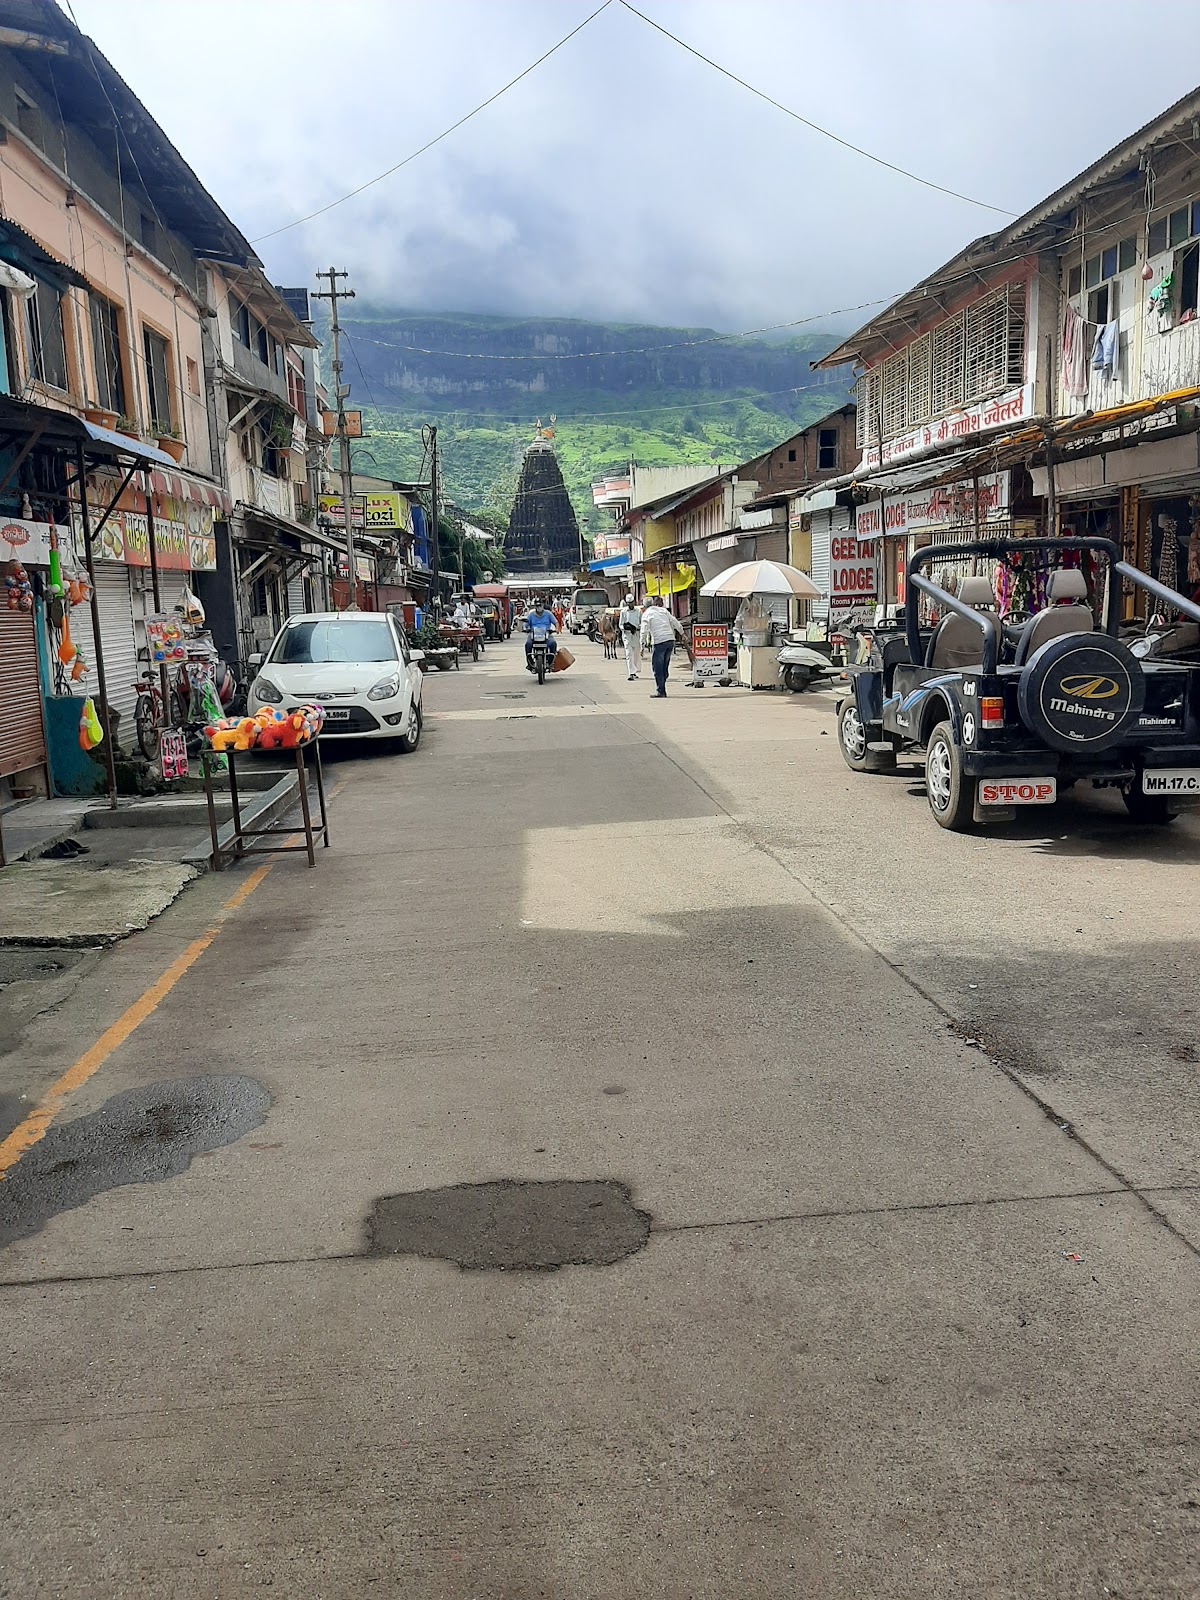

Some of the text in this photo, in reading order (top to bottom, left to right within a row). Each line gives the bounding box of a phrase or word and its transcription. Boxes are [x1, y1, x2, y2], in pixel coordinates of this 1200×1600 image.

[937, 420, 948, 441] श्री
[952, 411, 980, 437] गणेश
[984, 390, 1023, 425] ज्वेलर्स
[367, 499, 391, 507] UX
[366, 507, 393, 520] cozi
[858, 502, 905, 535] GEETAI ODGE
[832, 537, 874, 561] GEETAI
[833, 567, 873, 591] LODGE
[694, 628, 726, 637] GEETAI
[695, 640, 725, 648] LODGE
[1050, 698, 1115, 721] Mahindra
[983, 784, 1053, 800] STOP
